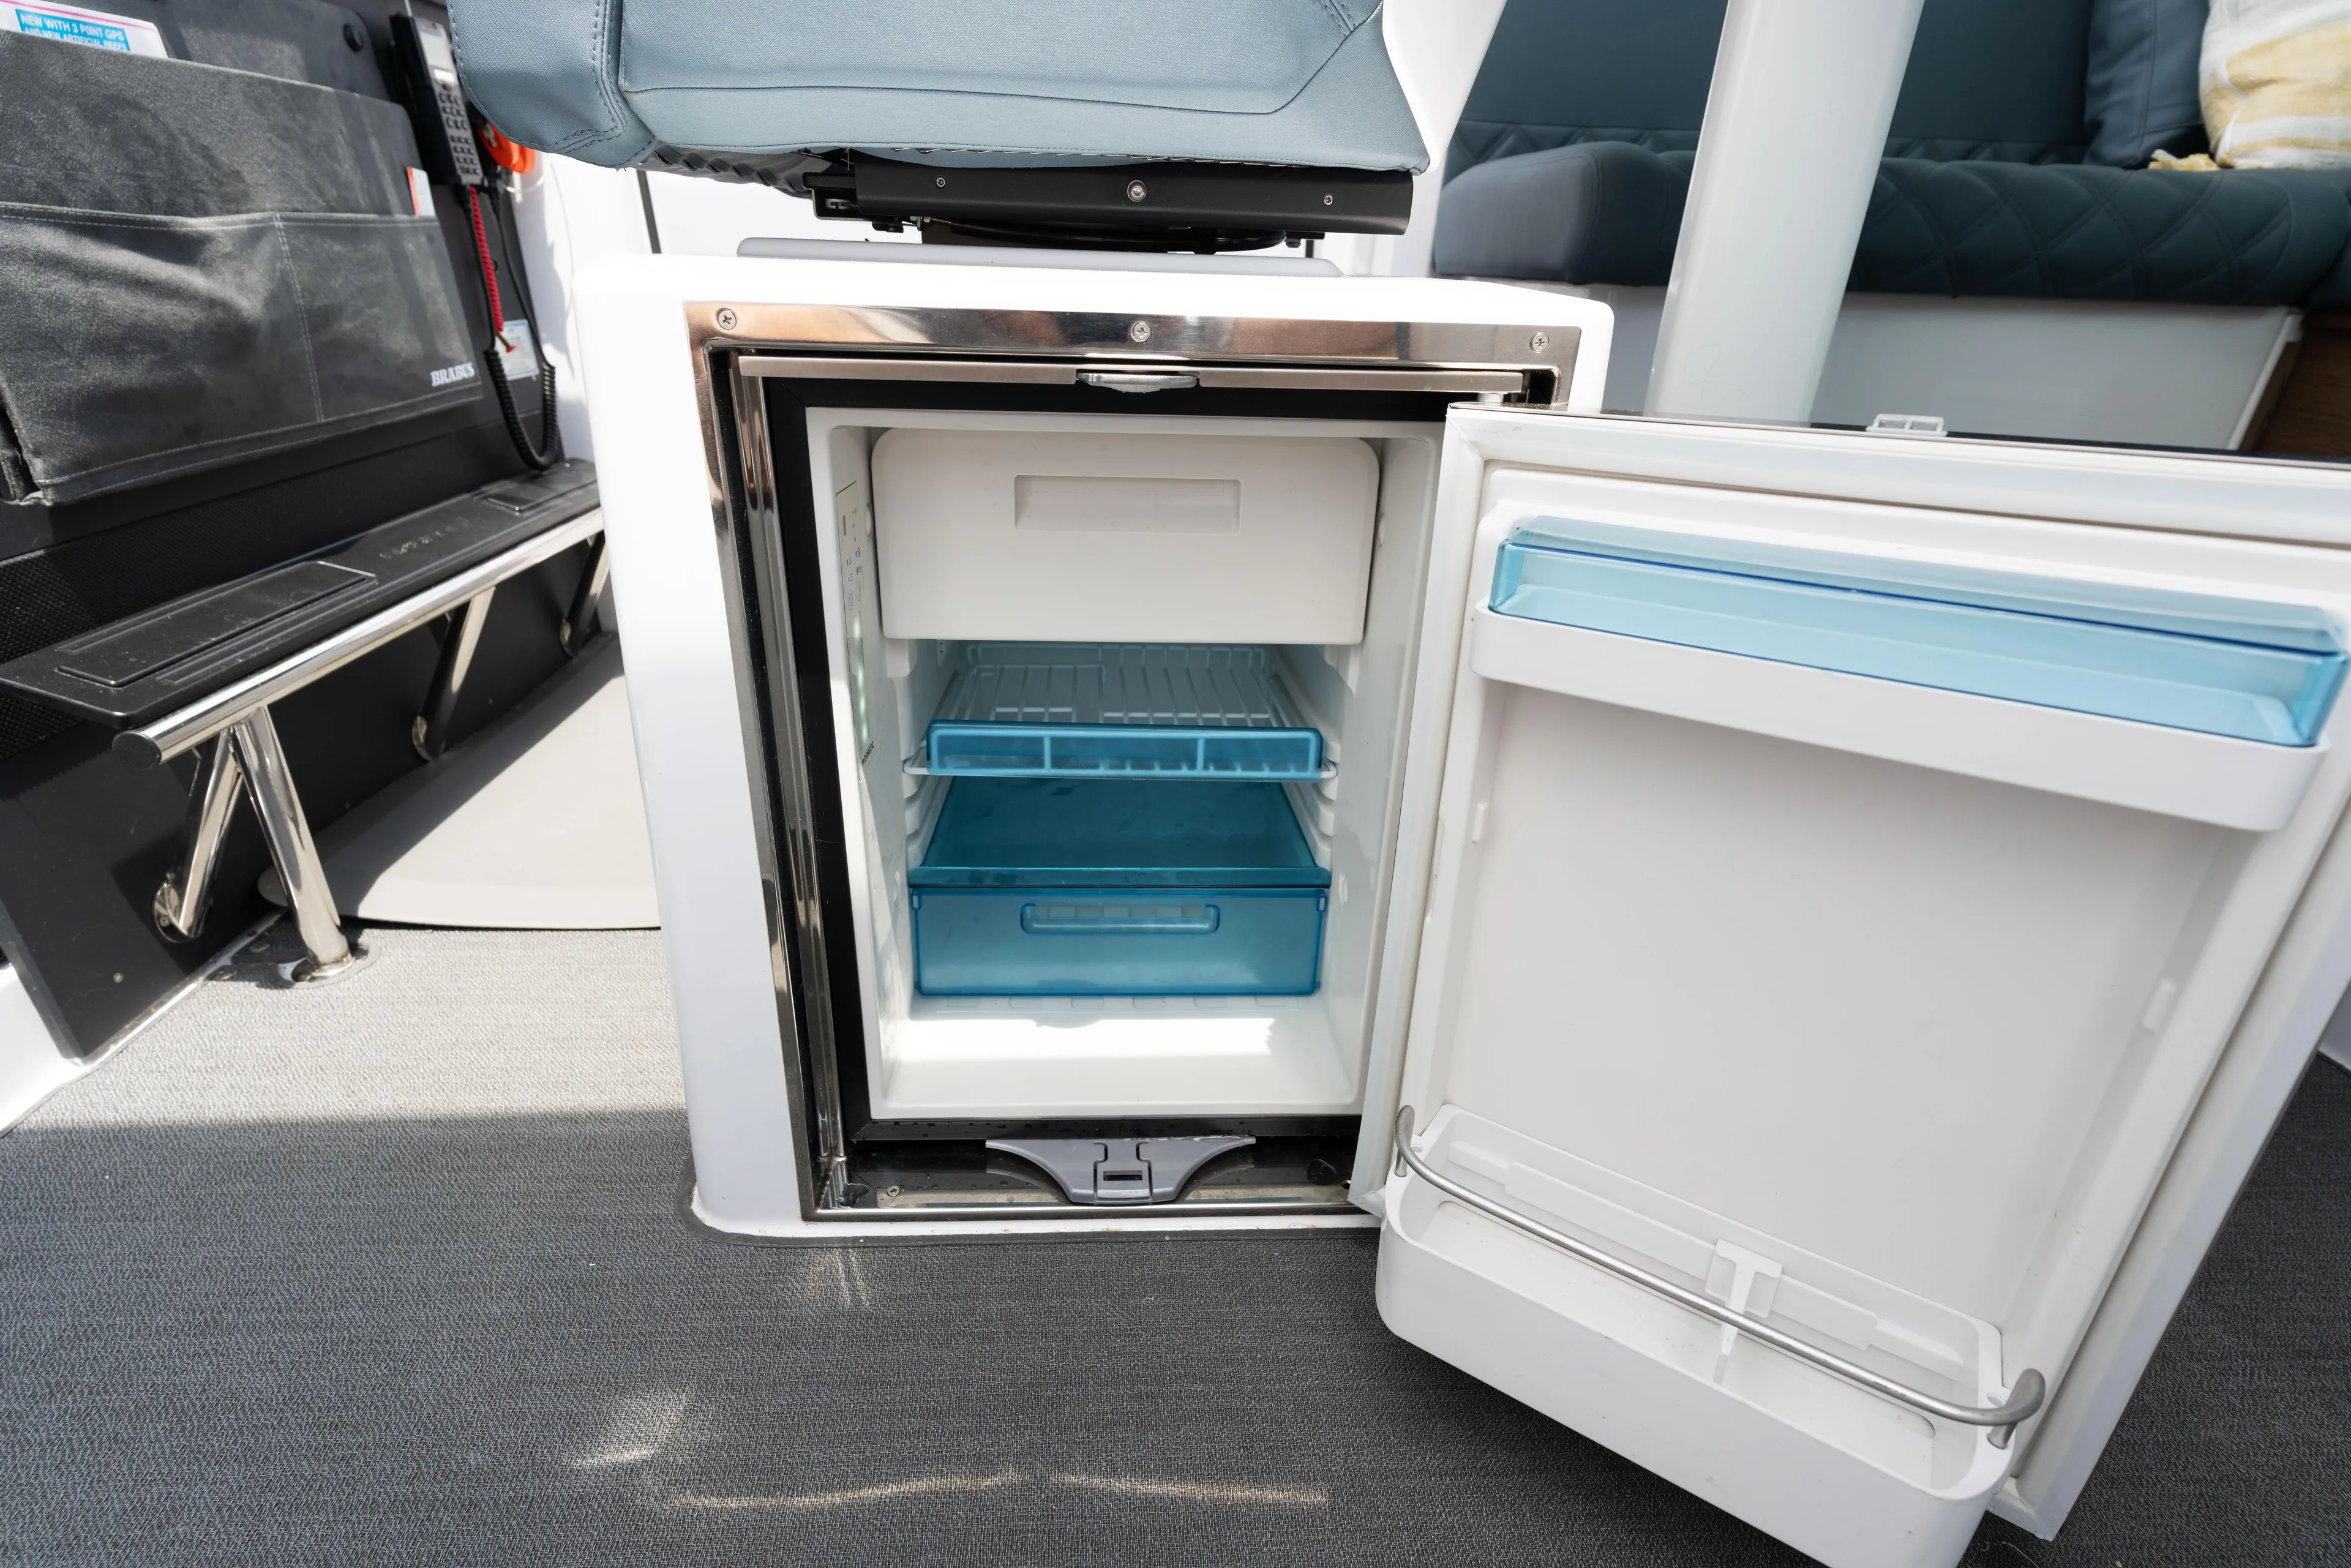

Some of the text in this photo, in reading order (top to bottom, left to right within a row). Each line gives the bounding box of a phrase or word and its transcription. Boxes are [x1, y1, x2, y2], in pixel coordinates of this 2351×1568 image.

[20, 13, 124, 42] NEW WITH 3 POINT GPS
[430, 362, 475, 387] BRABUS
[864, 740, 874, 763] DOMETIC
